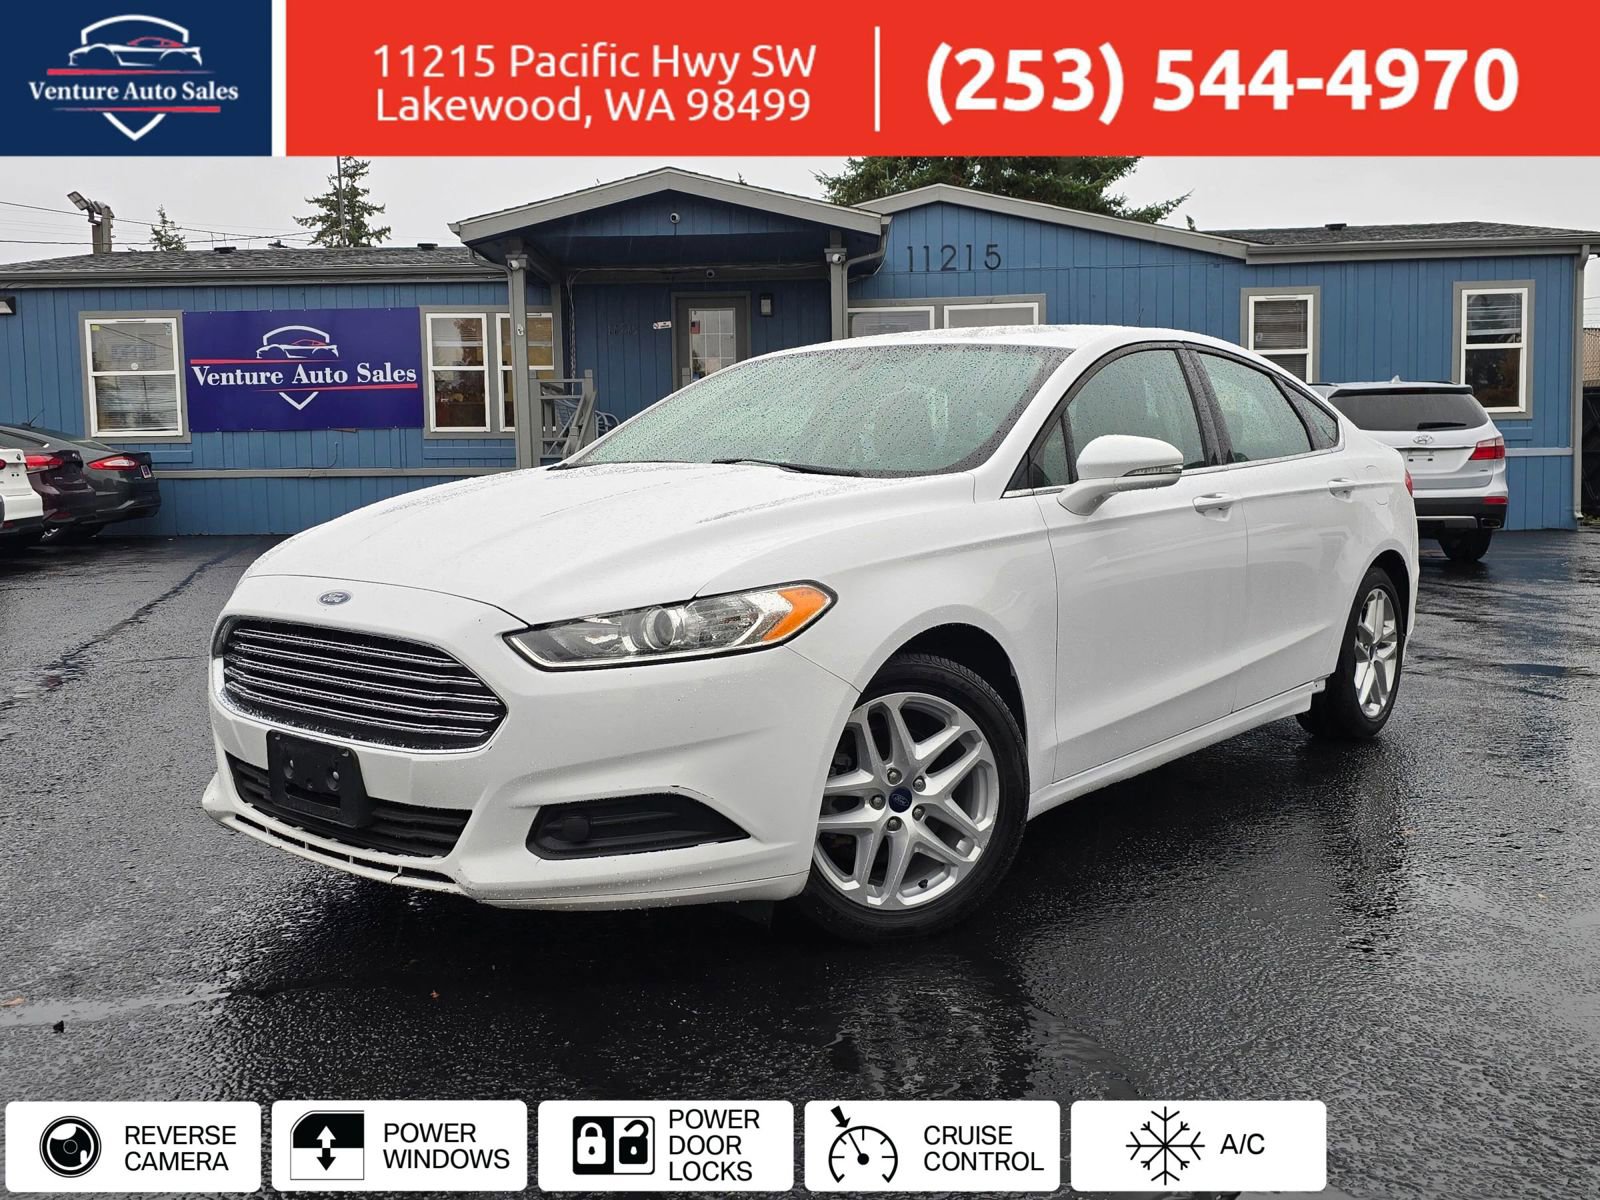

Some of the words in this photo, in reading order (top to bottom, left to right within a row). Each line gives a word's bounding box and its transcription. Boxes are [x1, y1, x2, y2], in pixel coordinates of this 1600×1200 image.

[907, 243, 1002, 272] 11215
[191, 365, 284, 386] Venture
[291, 363, 348, 384] Auto
[357, 362, 417, 383] Sales
